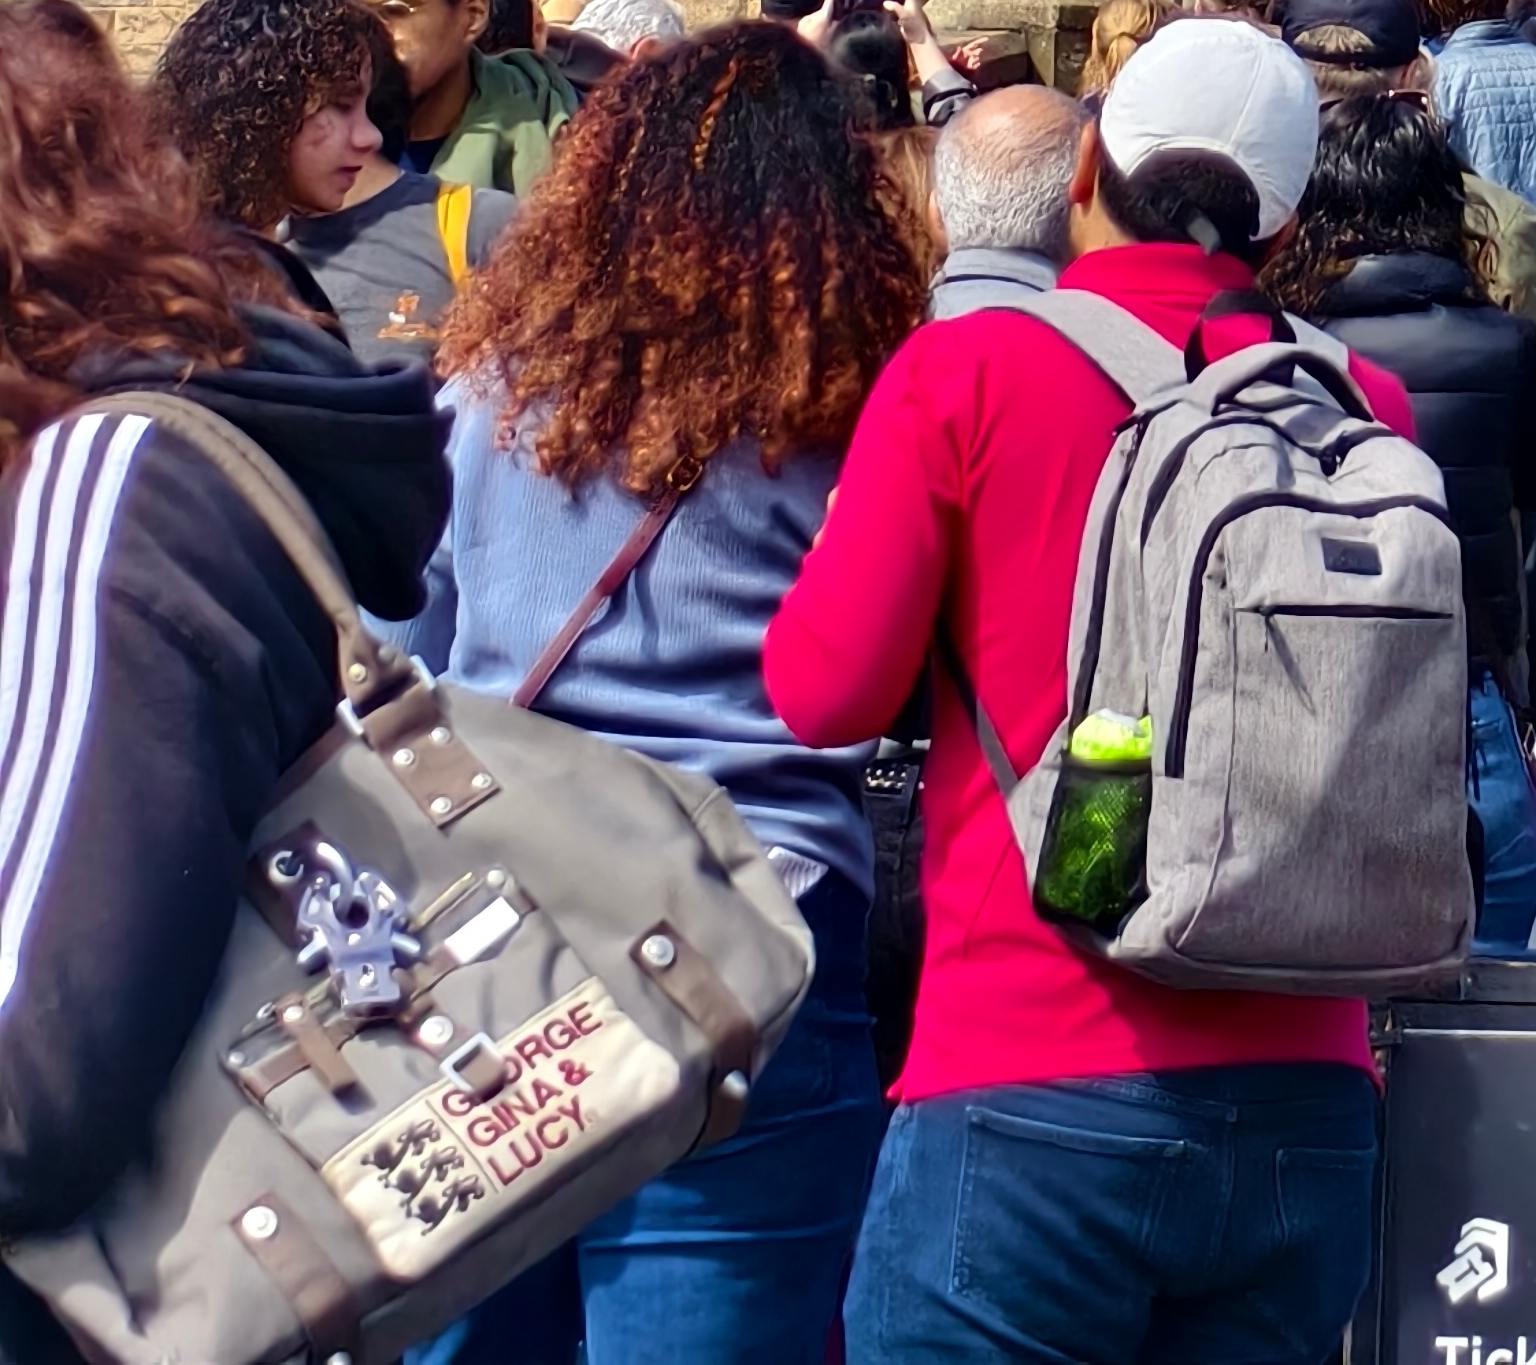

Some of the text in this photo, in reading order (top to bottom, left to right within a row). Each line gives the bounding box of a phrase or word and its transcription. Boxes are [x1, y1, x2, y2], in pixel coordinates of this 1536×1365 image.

[441, 1000, 603, 1117] GORGE
[467, 1058, 594, 1147] GINA &
[487, 1095, 585, 1186] LUCY
